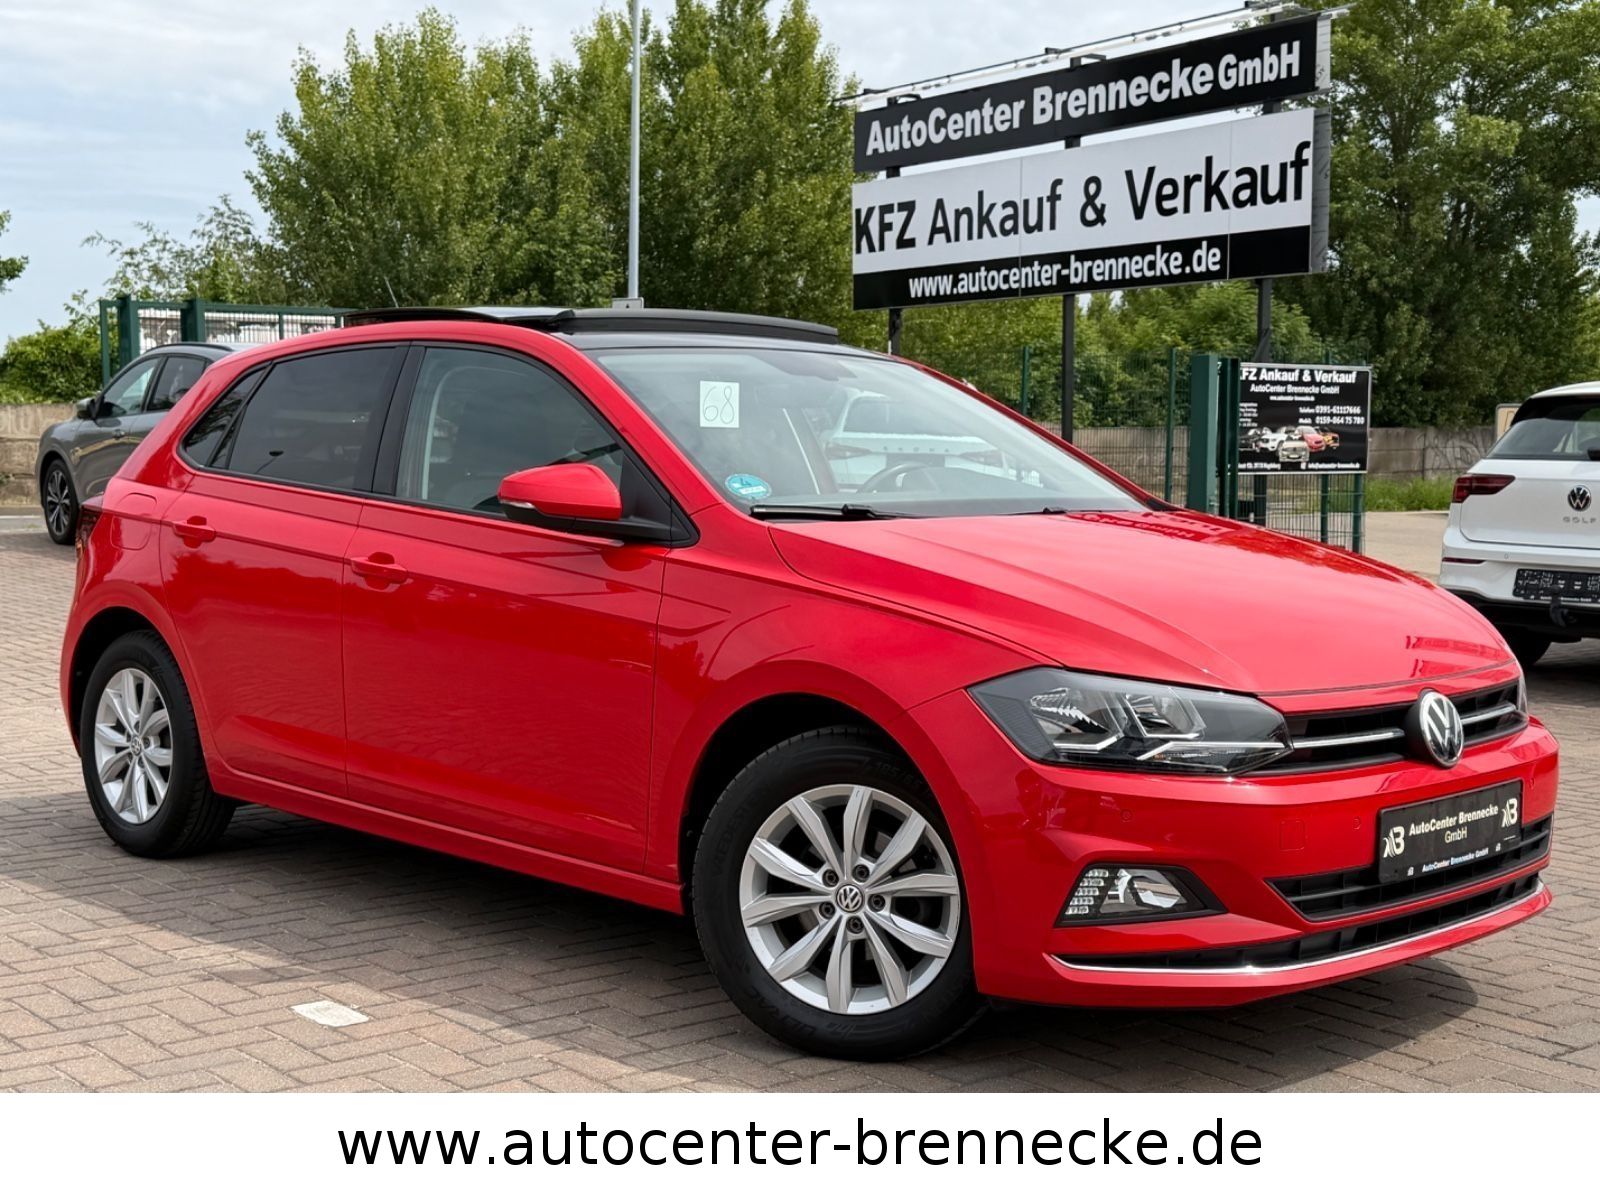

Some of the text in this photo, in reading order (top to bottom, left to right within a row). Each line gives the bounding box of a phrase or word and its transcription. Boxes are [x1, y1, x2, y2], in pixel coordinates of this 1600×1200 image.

[866, 40, 1301, 156] AutoCenter Brennecke GmbH
[854, 141, 1311, 255] KFZ Ankauf & Verkauf
[908, 241, 1221, 299] www.autocenter-brennecke.de
[1259, 369, 1299, 382] Ankauf
[1302, 370, 1312, 382] &
[1314, 370, 1357, 383] Verkauf
[1250, 384, 1287, 393] AutoCenter
[1320, 385, 1340, 395] GmbH
[703, 385, 735, 425] 68
[1562, 515, 1597, 523] GOLF
[1408, 803, 1499, 836] AutoCenter Brennecke
[1444, 827, 1468, 843] GmbH
[1422, 859, 1450, 873] AutoCenter
